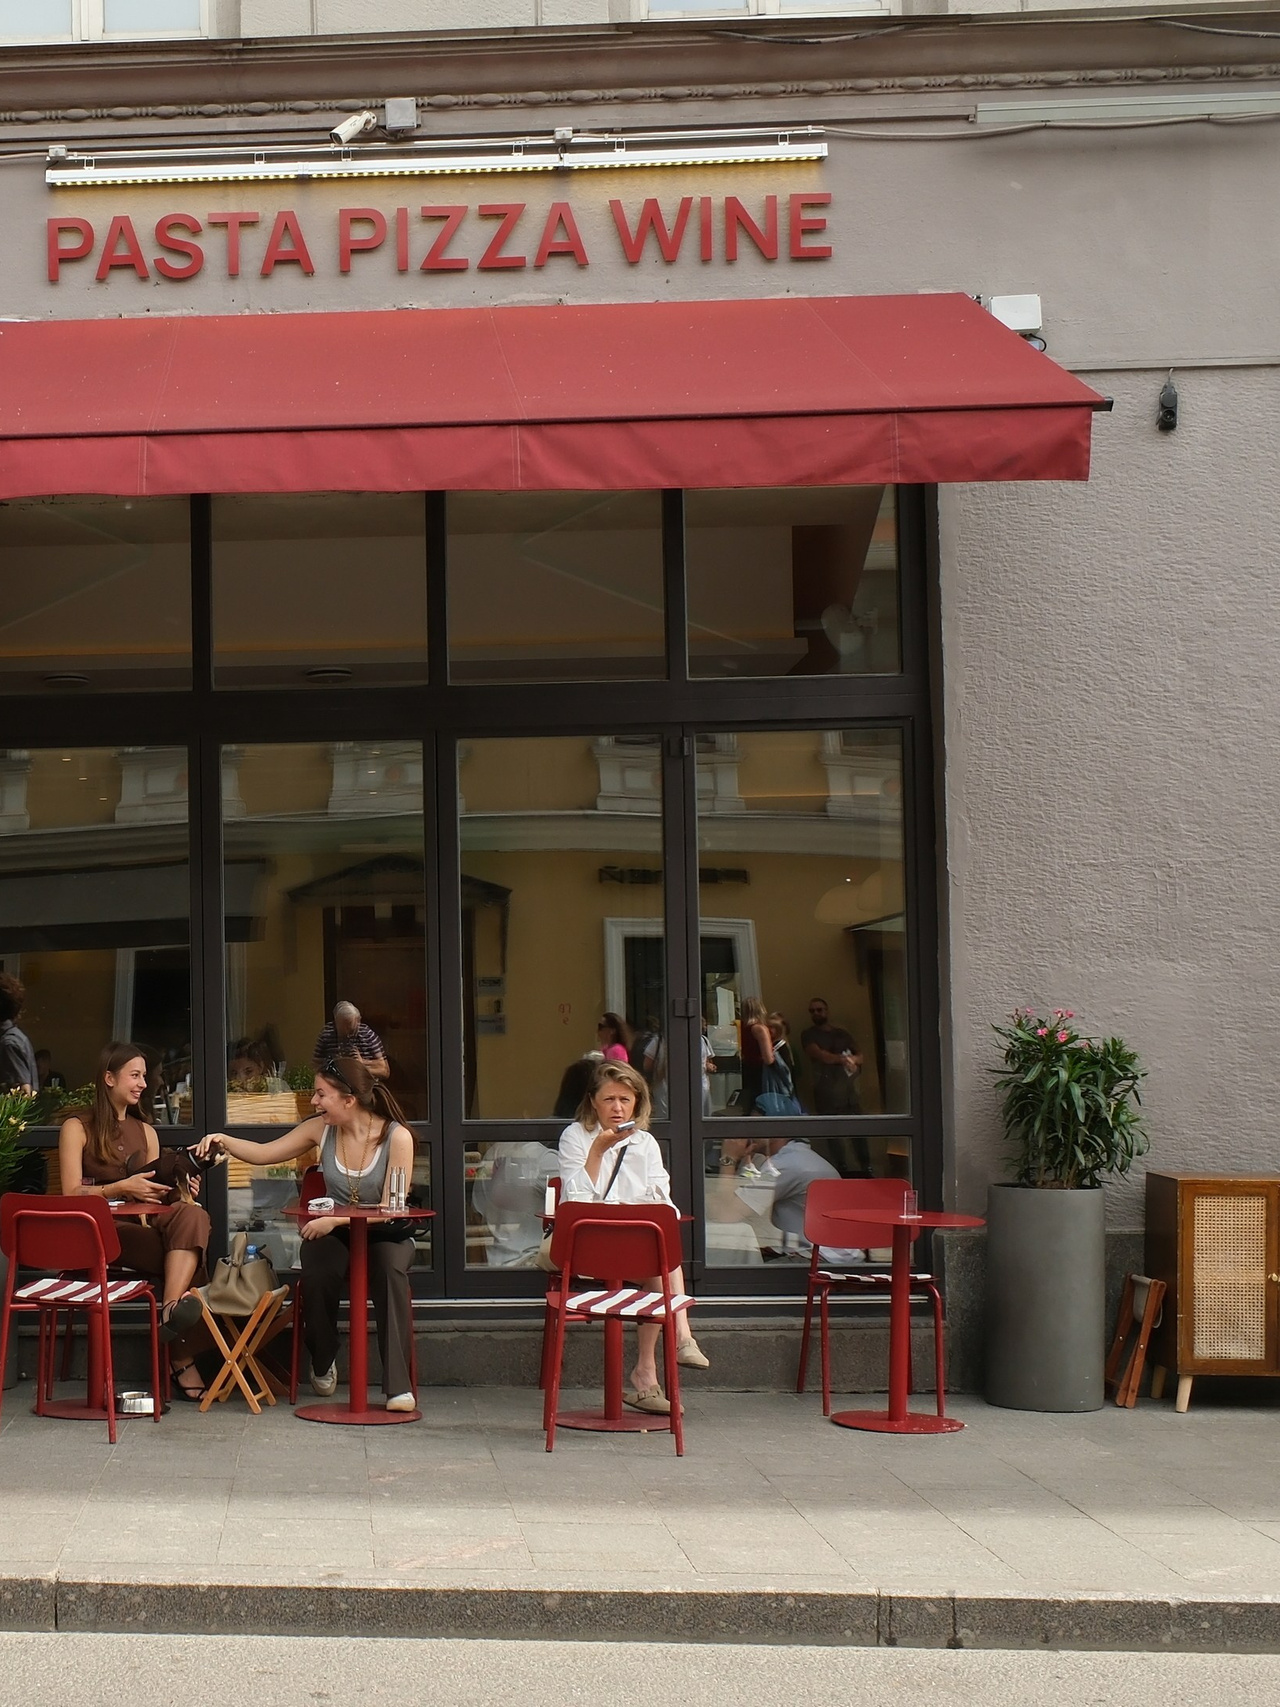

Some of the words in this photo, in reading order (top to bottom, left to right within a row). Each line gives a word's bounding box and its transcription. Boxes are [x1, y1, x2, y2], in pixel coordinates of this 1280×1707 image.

[47, 210, 315, 282] PASTA
[338, 201, 589, 273] PIZZA
[609, 192, 833, 263] WINE
